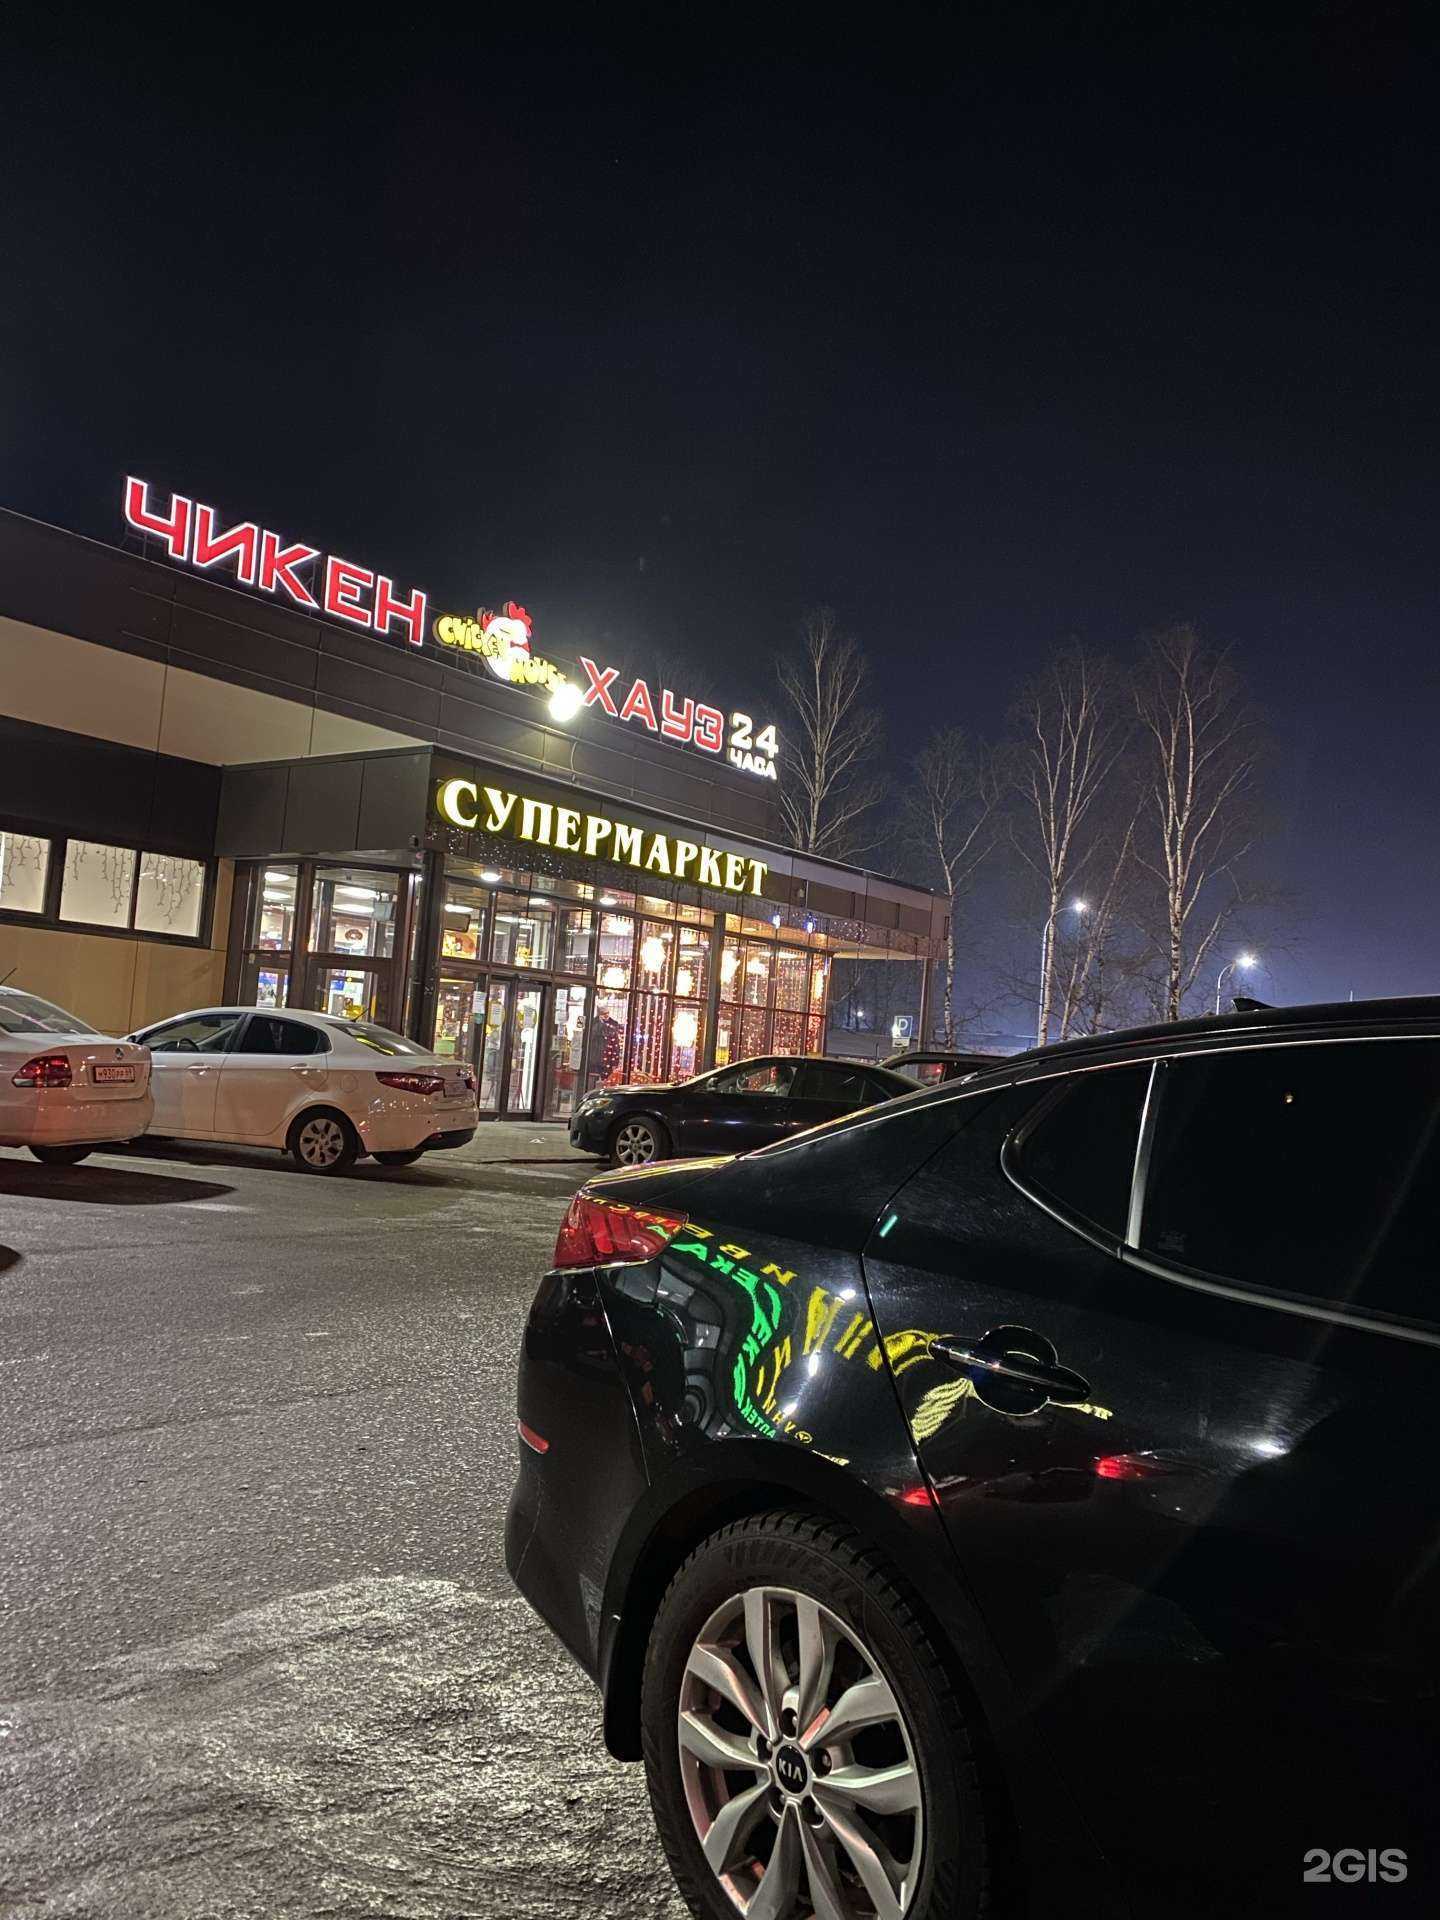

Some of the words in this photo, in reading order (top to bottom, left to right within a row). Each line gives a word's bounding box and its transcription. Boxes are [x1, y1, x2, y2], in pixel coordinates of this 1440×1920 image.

[125, 475, 427, 647] ЧИКЕН
[579, 656, 725, 753] ХАУЗ
[730, 711, 779, 759] 24
[440, 779, 769, 897] СУПЕРМАРКЕТ
[778, 1758, 804, 1783] KIA
